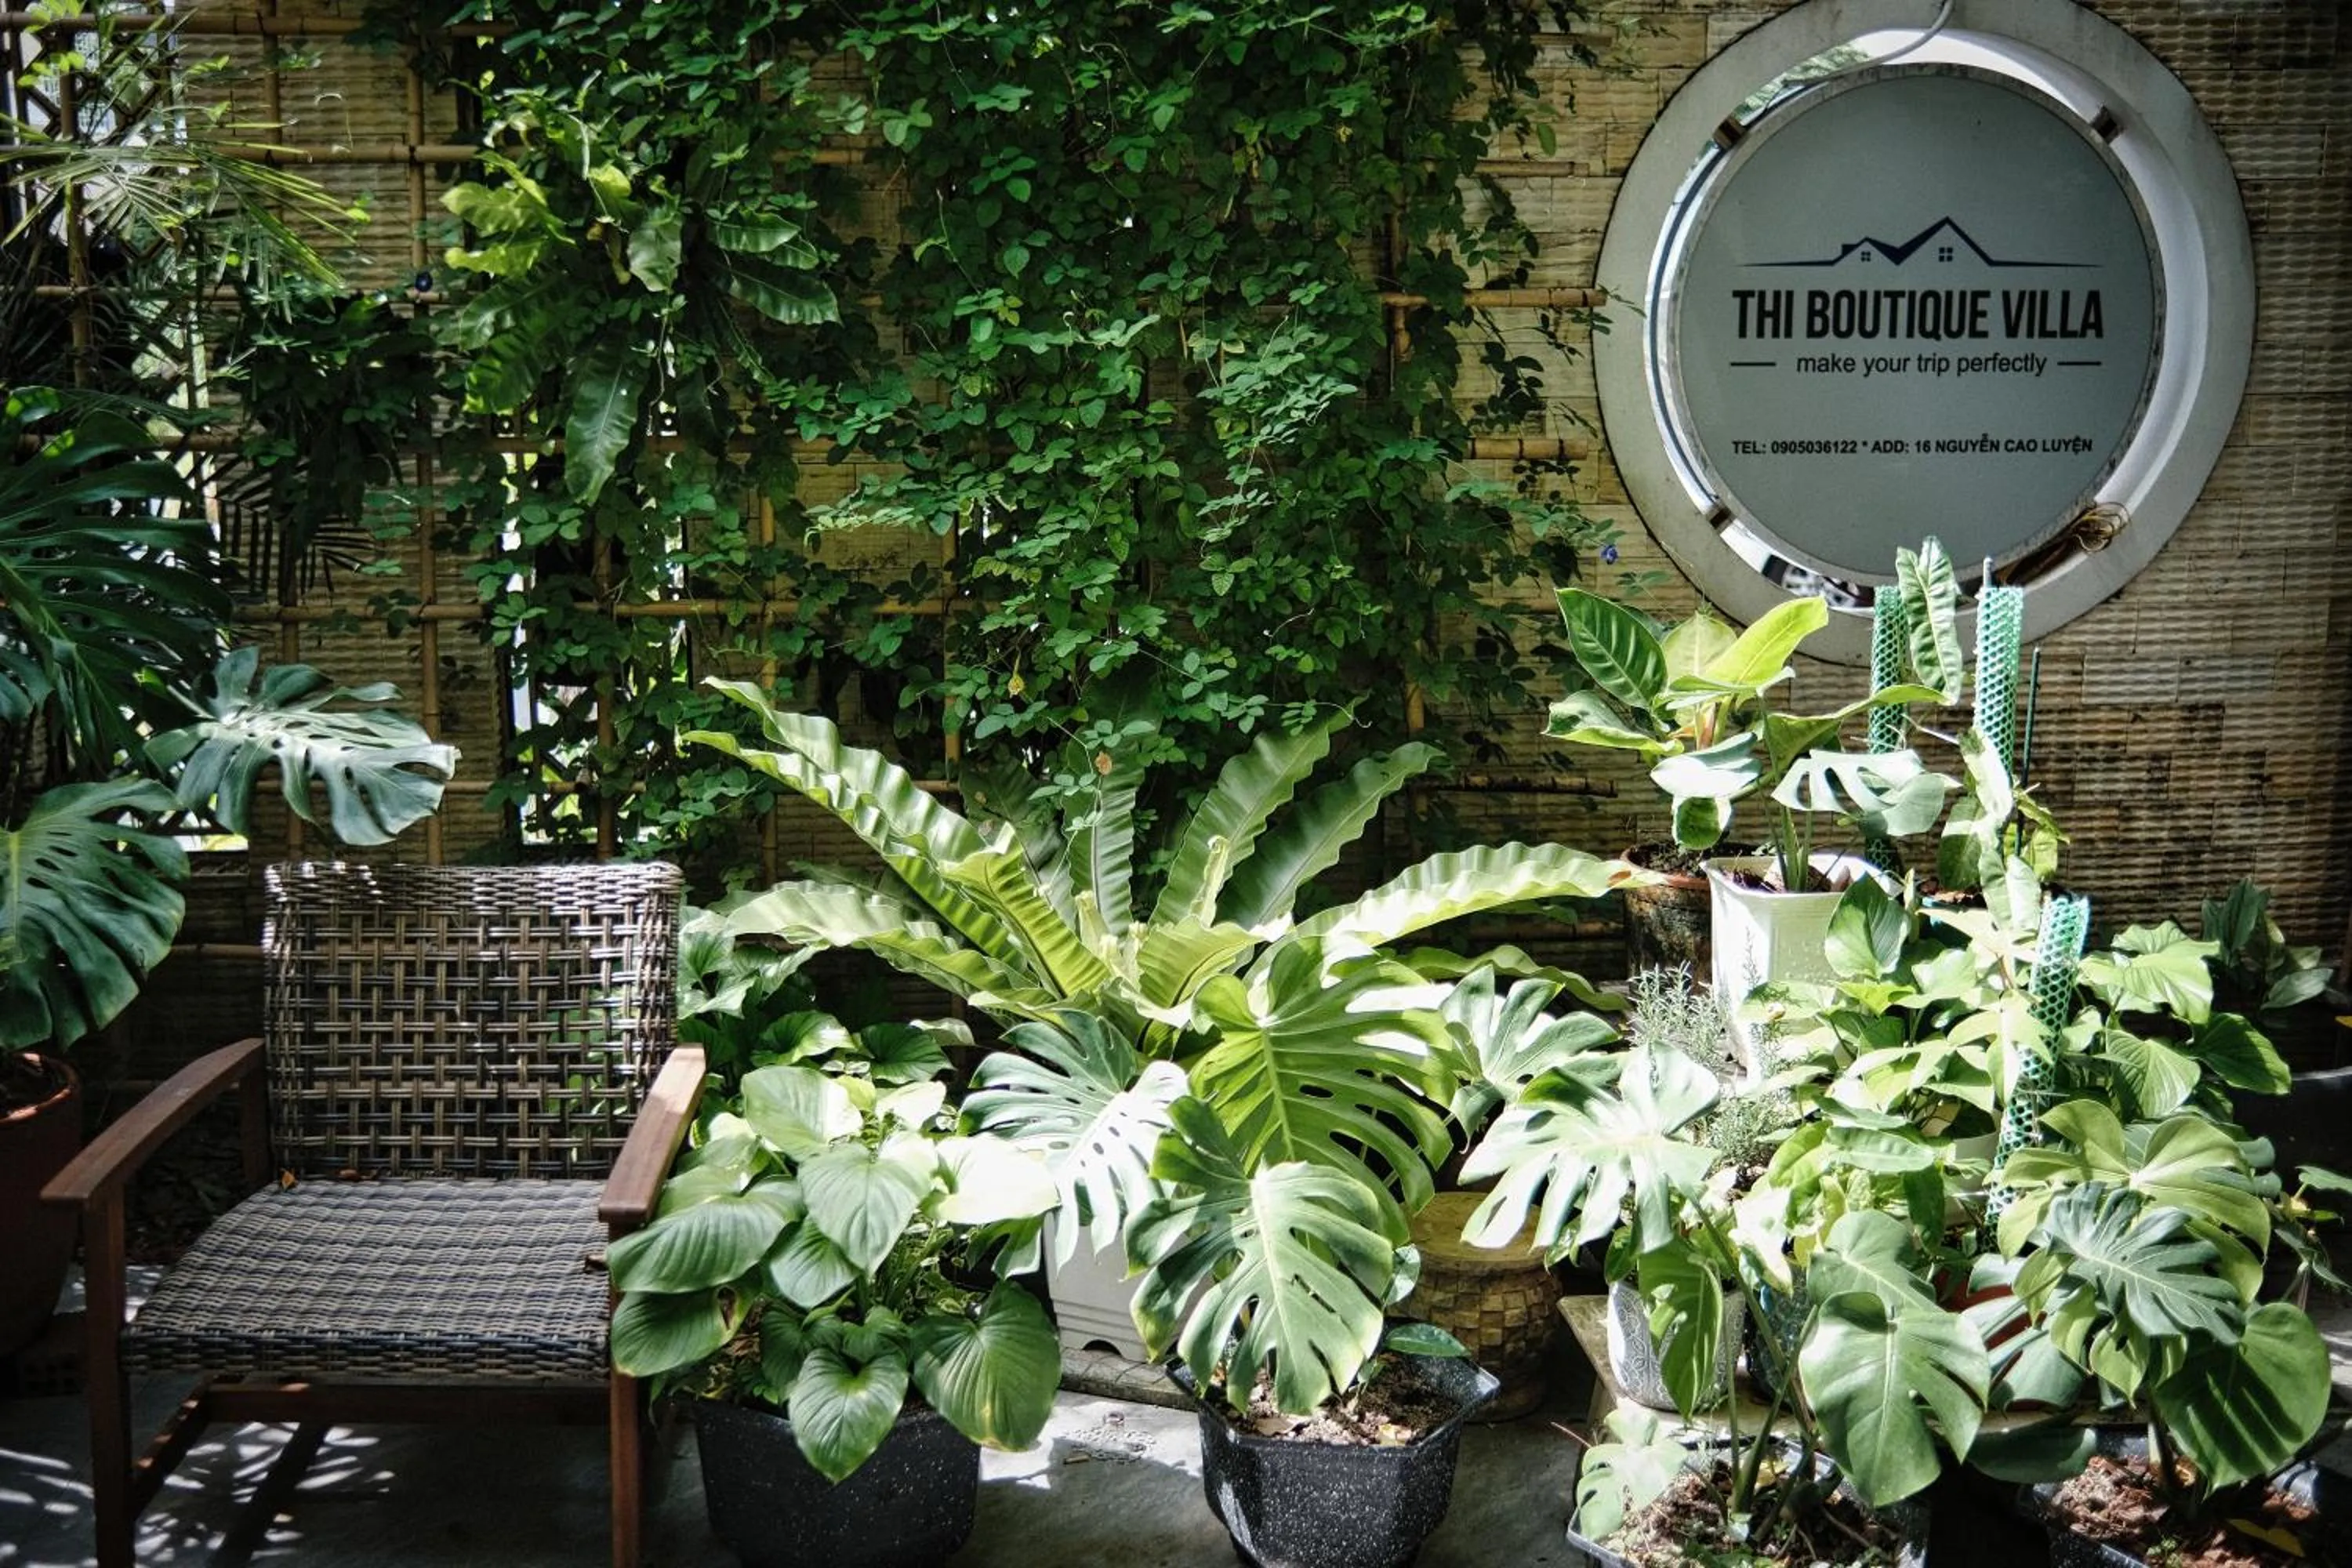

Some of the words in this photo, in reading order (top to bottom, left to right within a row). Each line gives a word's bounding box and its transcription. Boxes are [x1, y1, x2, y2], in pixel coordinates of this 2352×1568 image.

[1731, 289, 1795, 339] THI
[1806, 289, 1991, 342] BOUTIQUE
[2002, 289, 2104, 339] VILLA
[1796, 352, 1857, 375] make
[1862, 356, 1911, 379] your
[1916, 352, 1951, 379] trip
[1956, 351, 2048, 378] perfectly
[1731, 439, 1767, 455] TEL:
[1770, 439, 1858, 455] 0905036122
[1914, 439, 1932, 454] 16
[1934, 432, 2001, 454] NGUYỄN
[2003, 438, 2038, 454] CAO
[2042, 434, 2093, 456] LUYỆN
